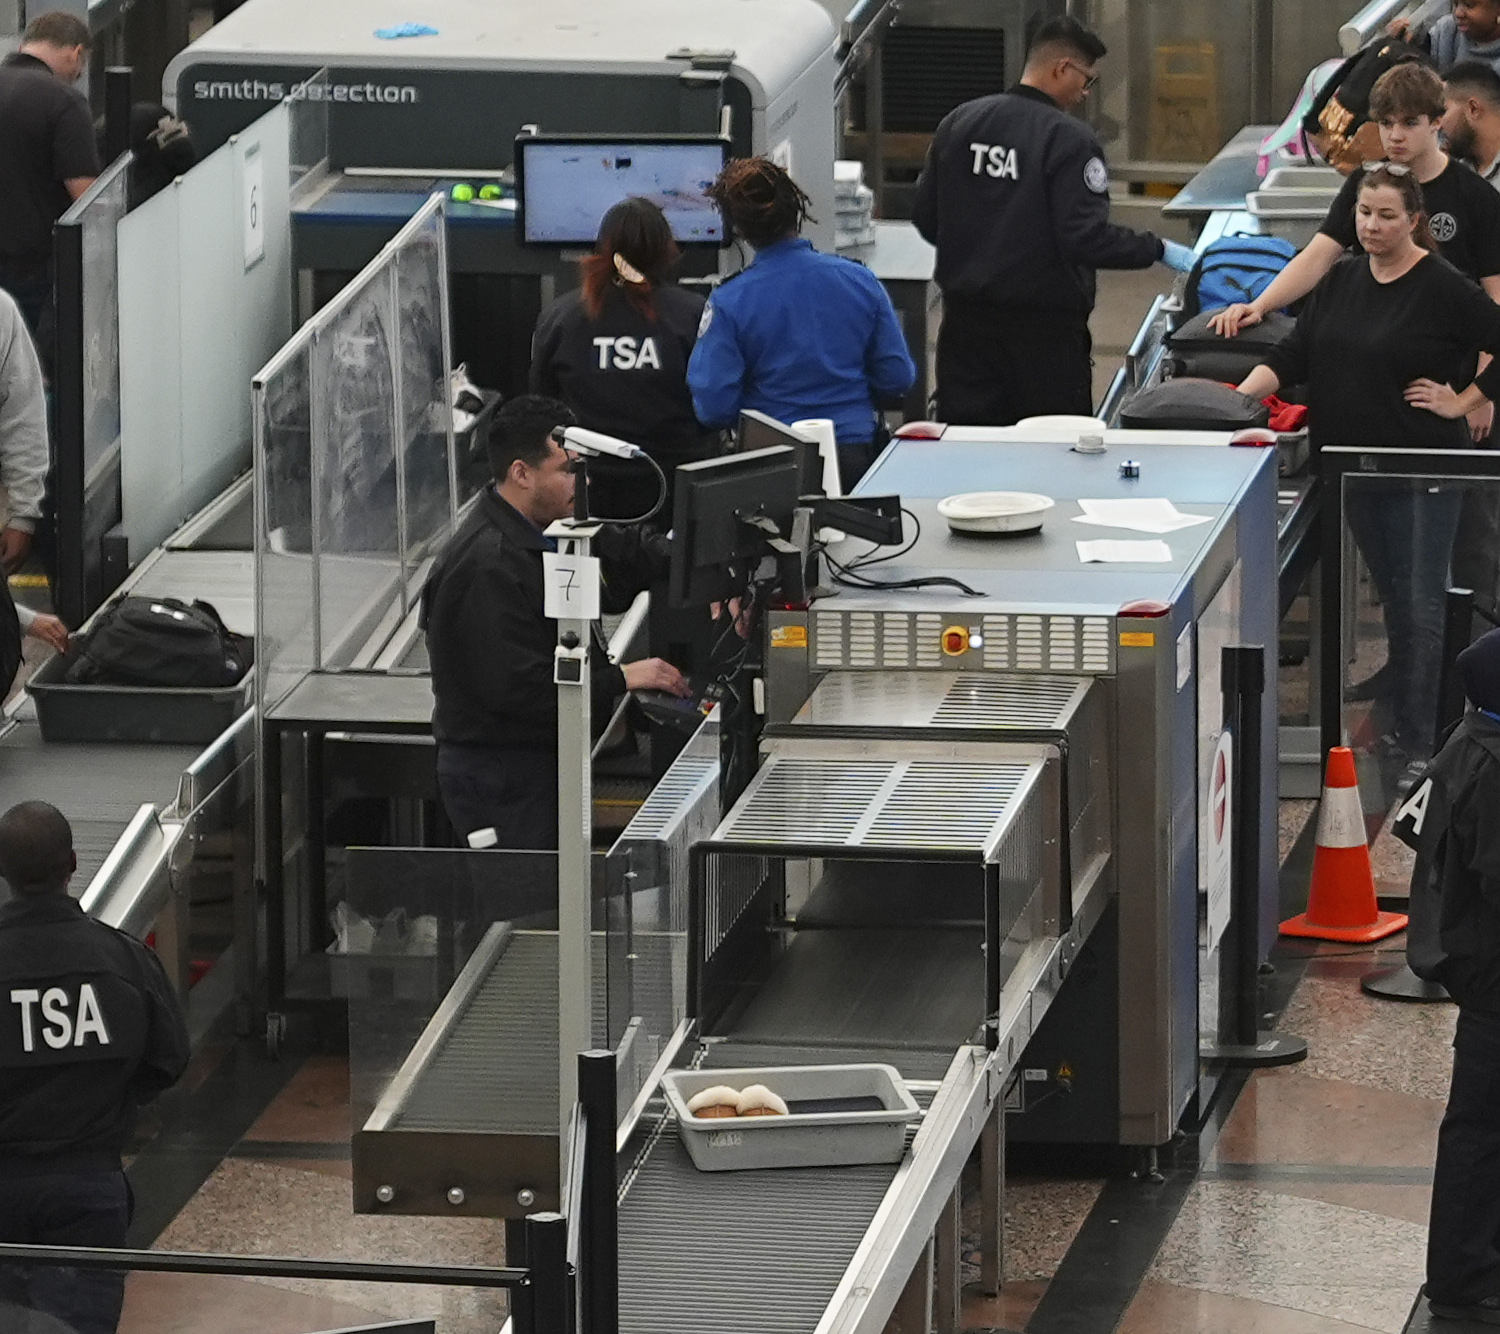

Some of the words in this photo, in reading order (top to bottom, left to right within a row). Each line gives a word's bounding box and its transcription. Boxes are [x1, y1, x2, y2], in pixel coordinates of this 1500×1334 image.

[194, 78, 284, 100] smiths
[289, 78, 416, 103] detection
[969, 142, 1019, 181] TSA
[250, 184, 258, 231] 6
[592, 336, 661, 370] TSA
[556, 568, 580, 601] 7
[10, 983, 111, 1052] TSA
